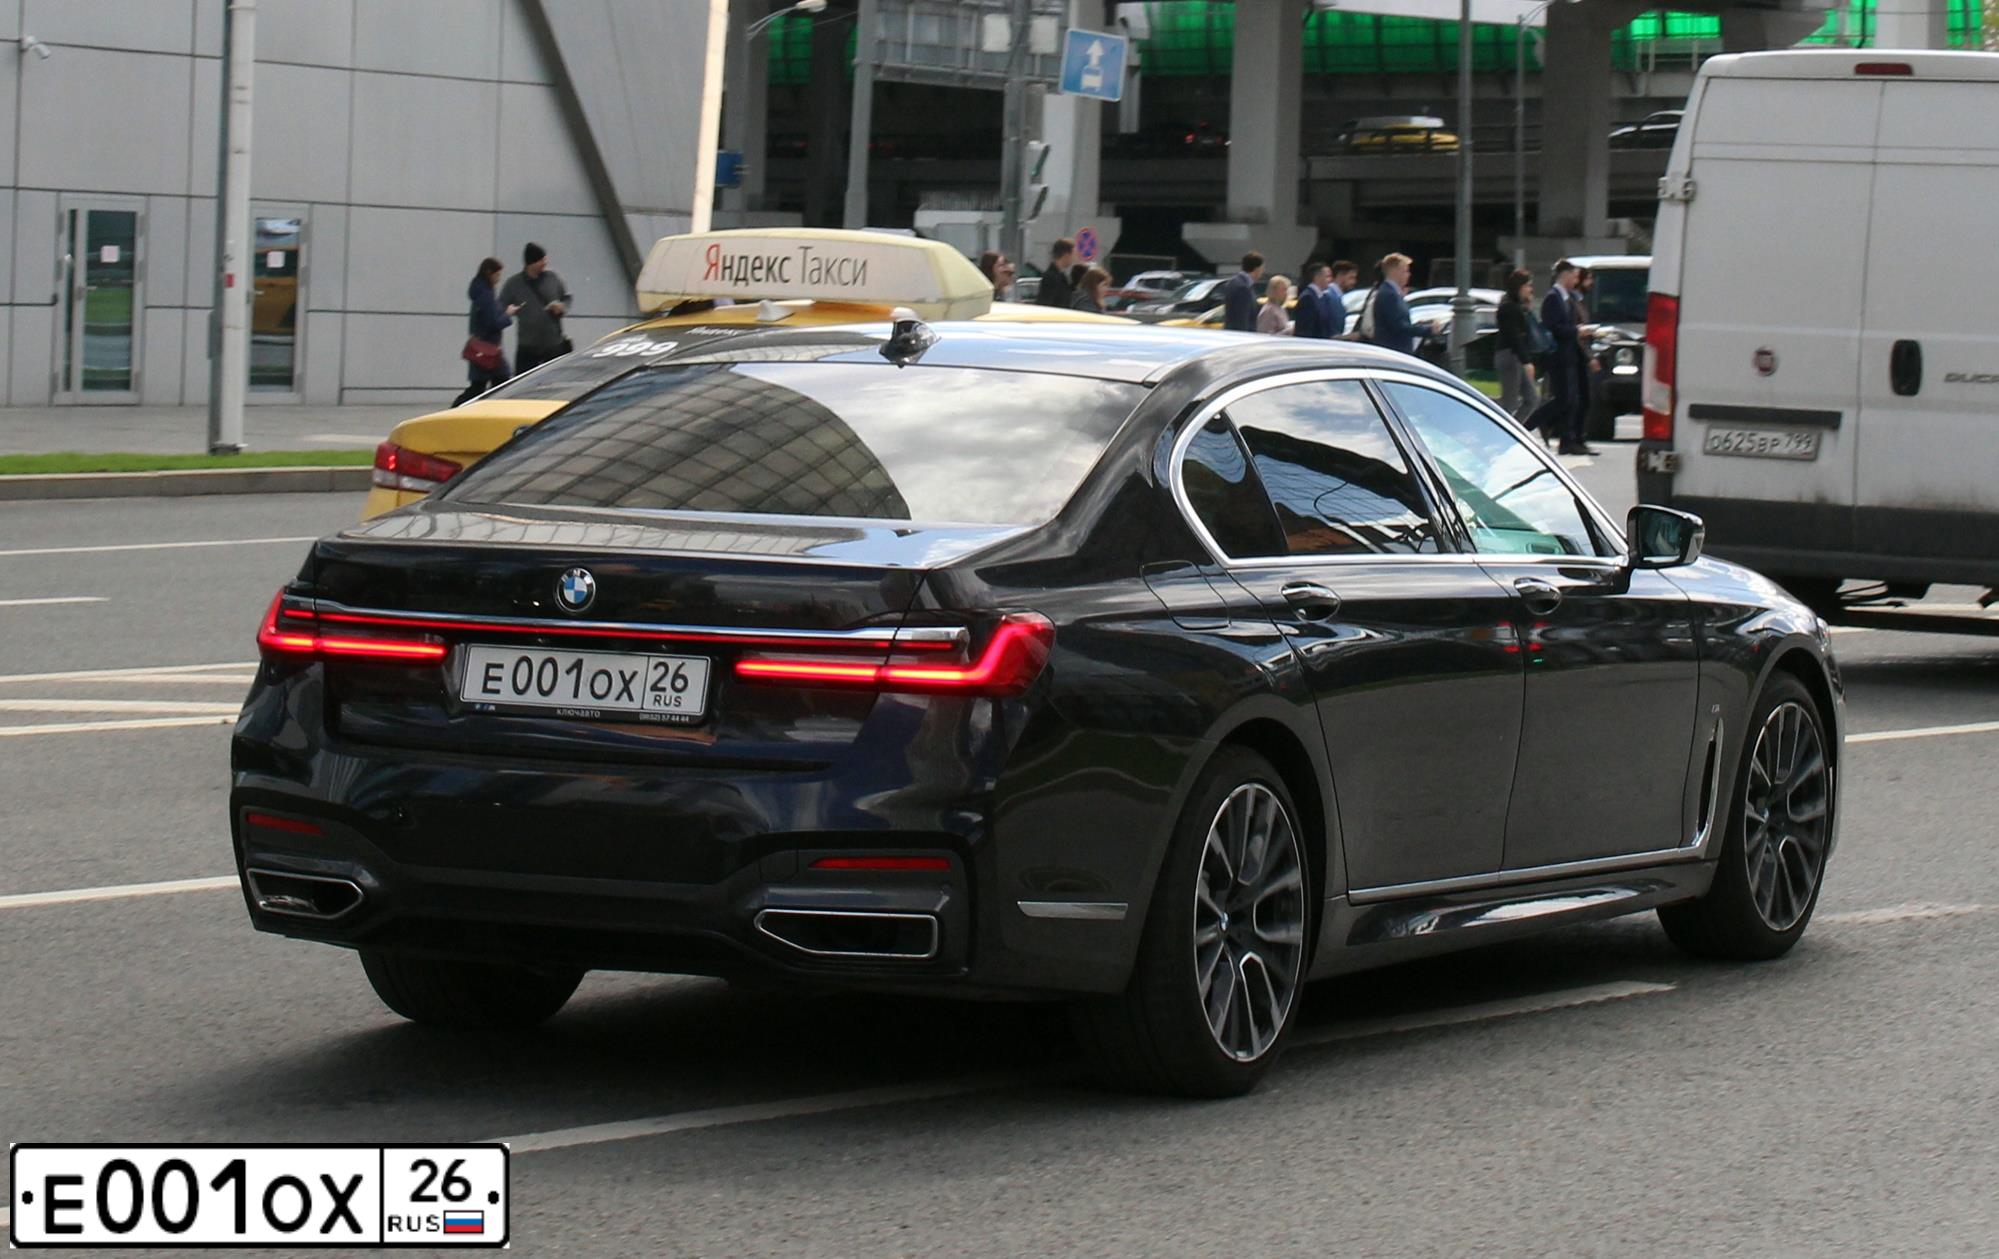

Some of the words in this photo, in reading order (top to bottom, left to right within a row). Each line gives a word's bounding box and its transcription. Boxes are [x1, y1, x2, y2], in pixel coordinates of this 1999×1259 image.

[704, 243, 791, 287] Яндекс
[799, 246, 868, 287] Такси
[592, 341, 679, 358] 999
[649, 660, 689, 693] 26
[652, 694, 683, 708] RUS
